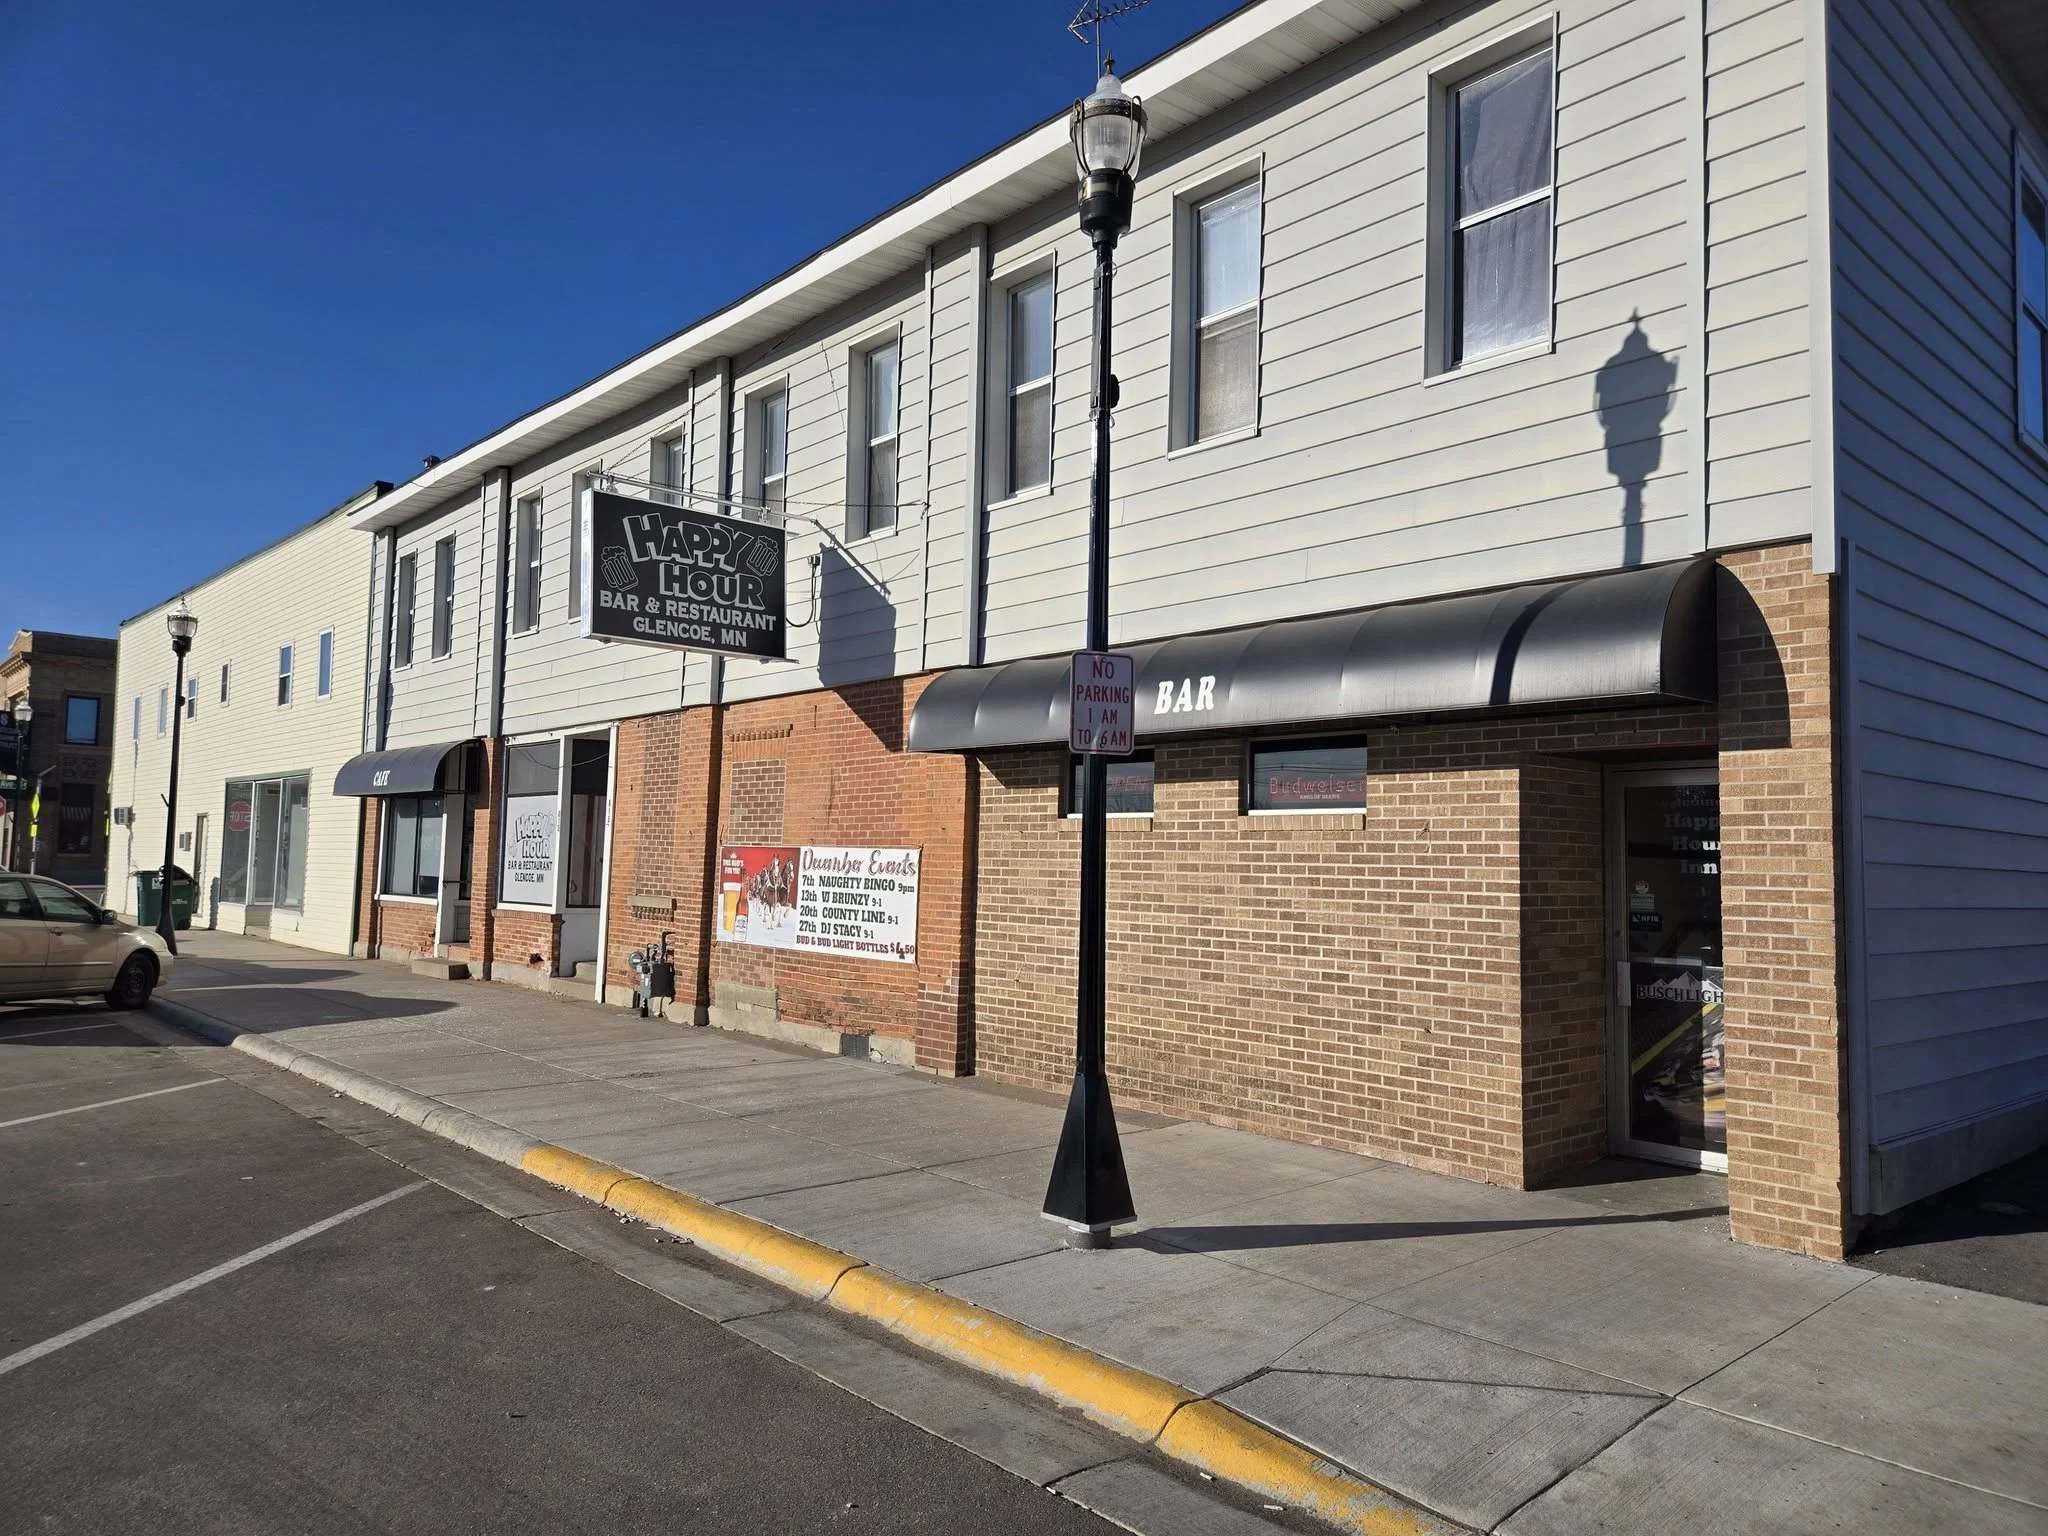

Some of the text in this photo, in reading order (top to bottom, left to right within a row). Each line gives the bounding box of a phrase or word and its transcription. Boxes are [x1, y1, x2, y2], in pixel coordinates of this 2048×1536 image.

[622, 512, 754, 572] HAPPY
[659, 562, 765, 611] HOUR
[600, 590, 776, 631] BAR & RESTAURANT
[633, 616, 747, 647] GLENCOE, MN
[1092, 661, 1114, 679] NO
[1076, 684, 1129, 703] PARKING
[1154, 675, 1215, 714] BAR
[1101, 708, 1118, 724] AM
[1077, 729, 1091, 744] TO
[1269, 777, 1364, 794] Budweiser
[515, 812, 549, 843] HAPPY
[1664, 813, 1719, 831] Happ
[522, 838, 550, 859] HOUR
[508, 860, 517, 870] BAR
[523, 861, 552, 871] RESTAURANT
[803, 848, 916, 876] December Events
[1680, 859, 1718, 874] Inn
[536, 873, 544, 883] MN
[802, 875, 914, 894] 7th NAUGHTY BINGO 9pm
[801, 890, 882, 907] 13th VJ BRUNZY 9-1
[800, 905, 899, 925] 20th COUNTY LINE 9-1
[799, 920, 874, 939] 27th DJ STACY 9-1
[796, 935, 809, 945] BUD
[811, 937, 816, 945] &
[817, 937, 831, 947] BUD
[833, 939, 854, 950] LIGHT
[856, 941, 889, 954] BOTTLES
[1637, 984, 1724, 1003] BUSCH LIGH
